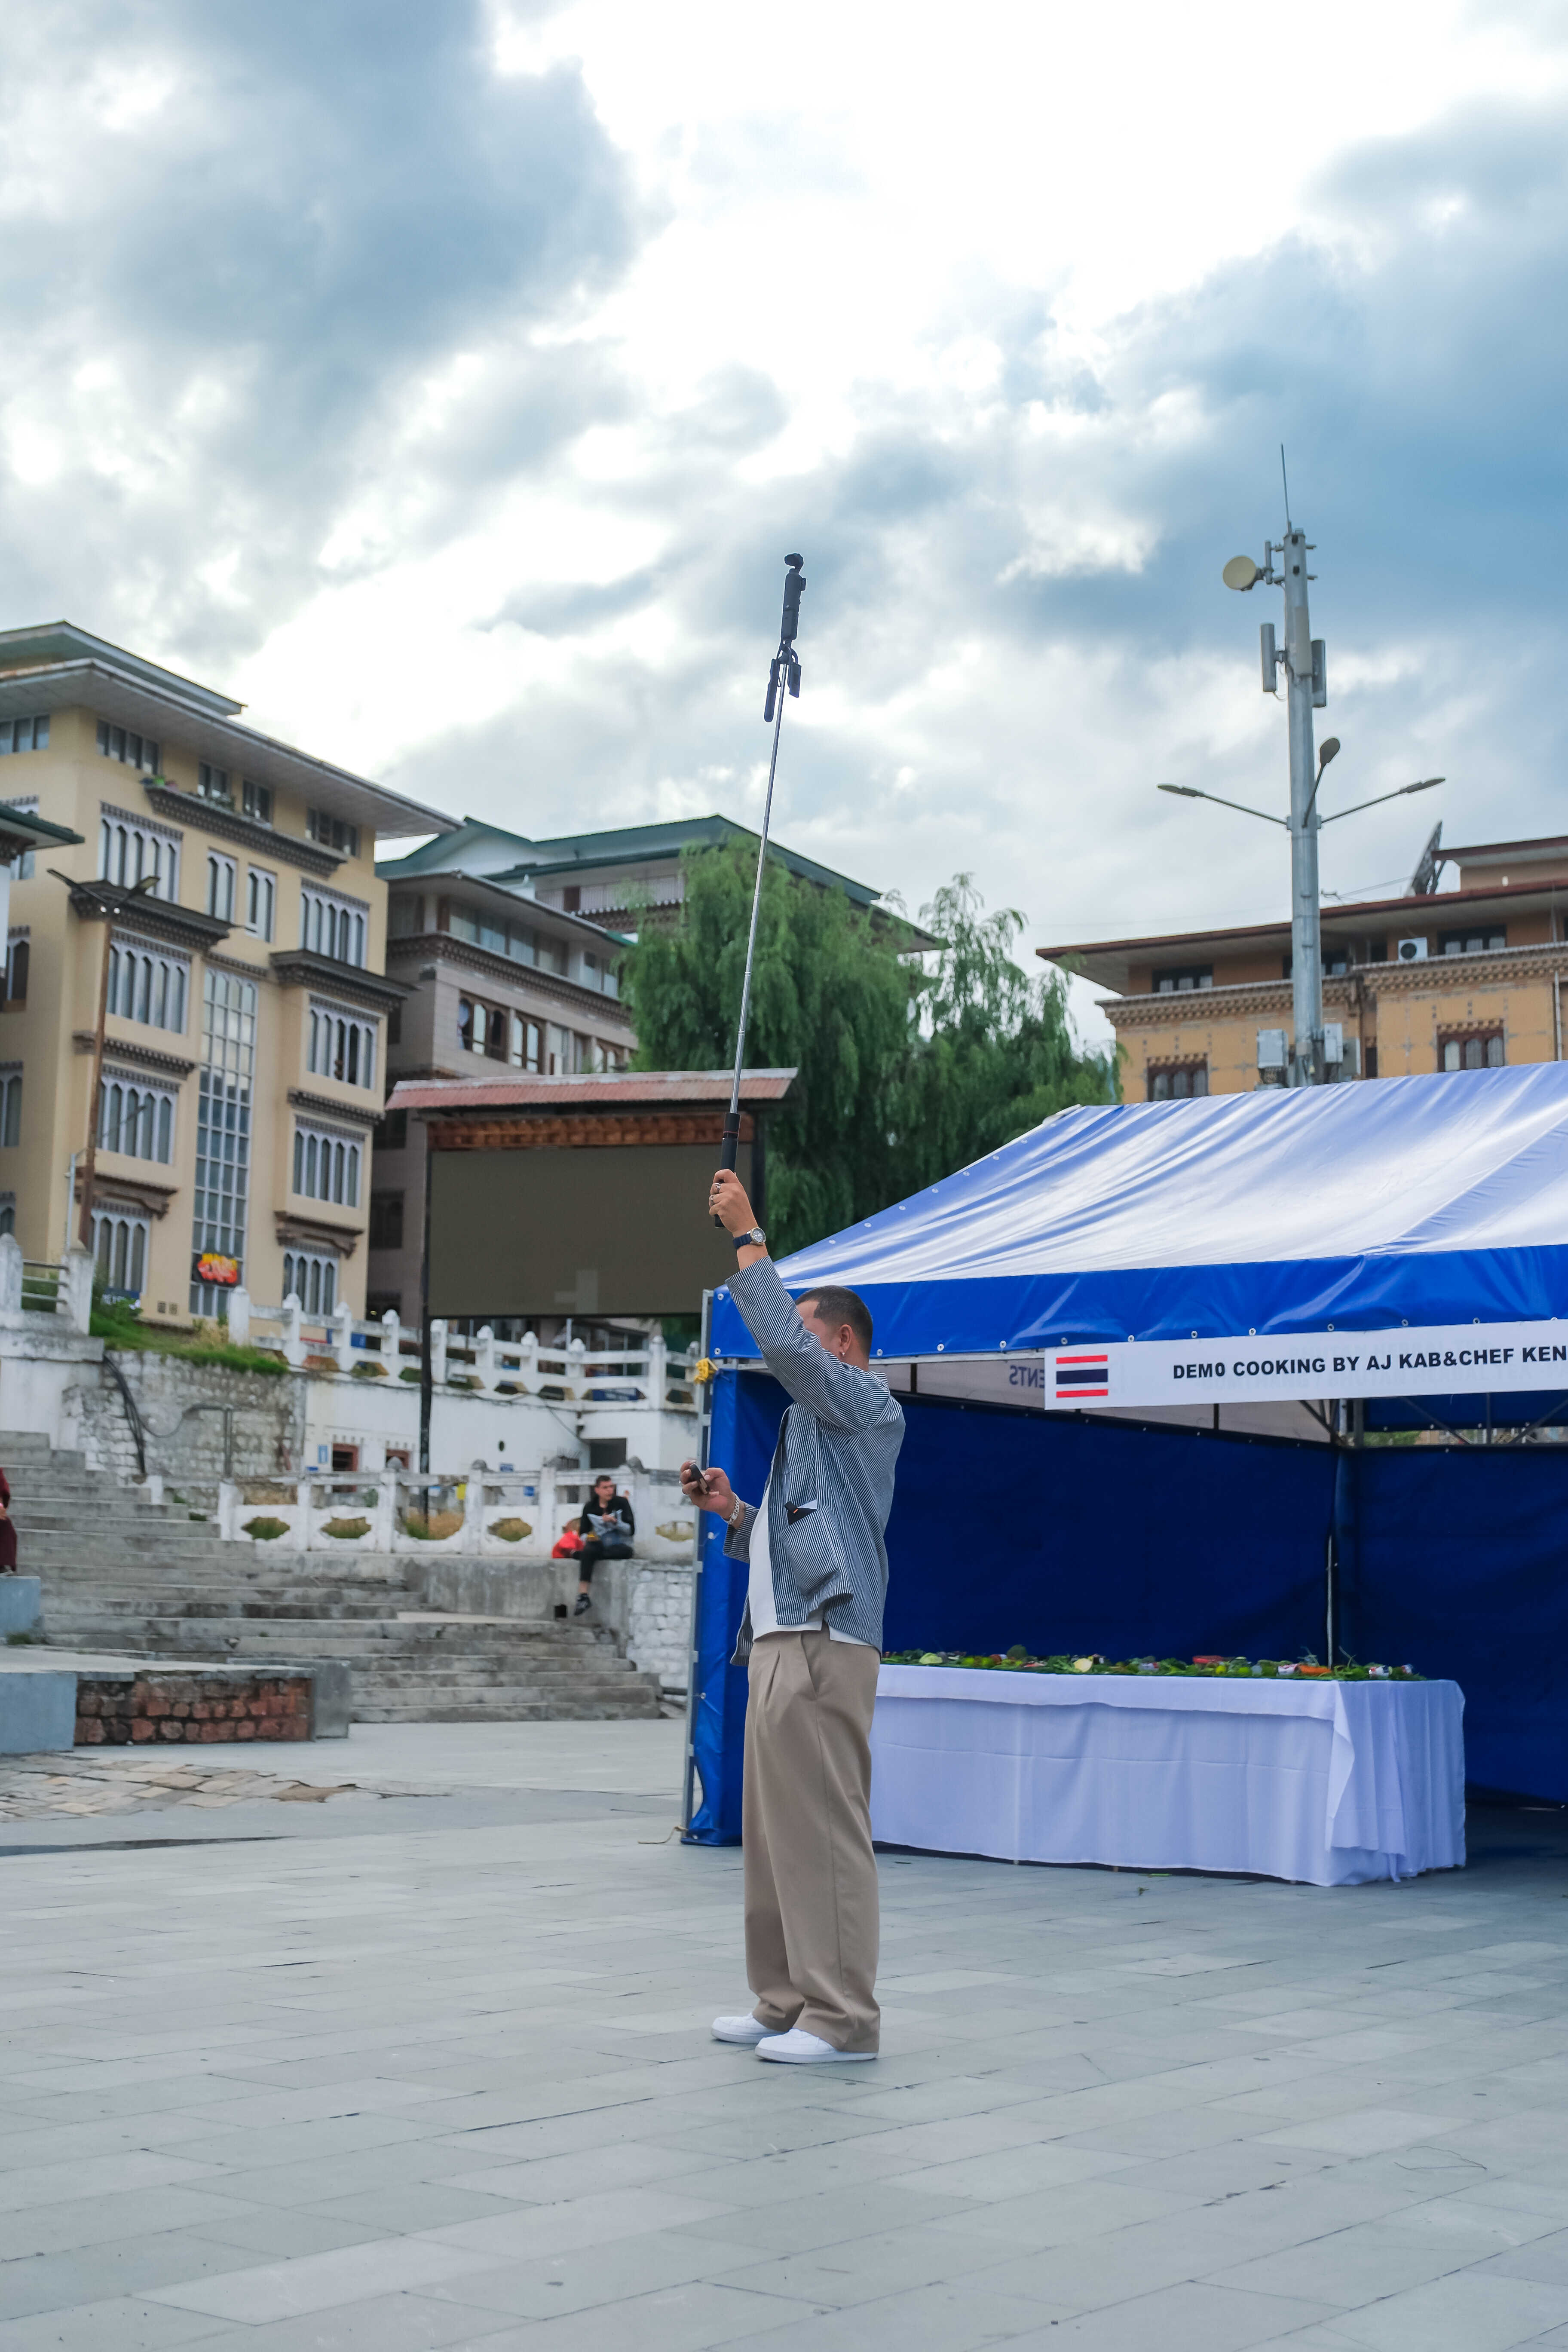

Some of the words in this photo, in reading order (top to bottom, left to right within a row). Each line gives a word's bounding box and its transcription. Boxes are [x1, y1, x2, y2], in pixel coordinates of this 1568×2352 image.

[1233, 1358, 1325, 1376] COOKING
[1333, 1356, 1360, 1372] BY
[1366, 1355, 1391, 1370] AJ
[1399, 1348, 1514, 1369] KAB&CHEF
[1522, 1345, 1566, 1362] KEN
